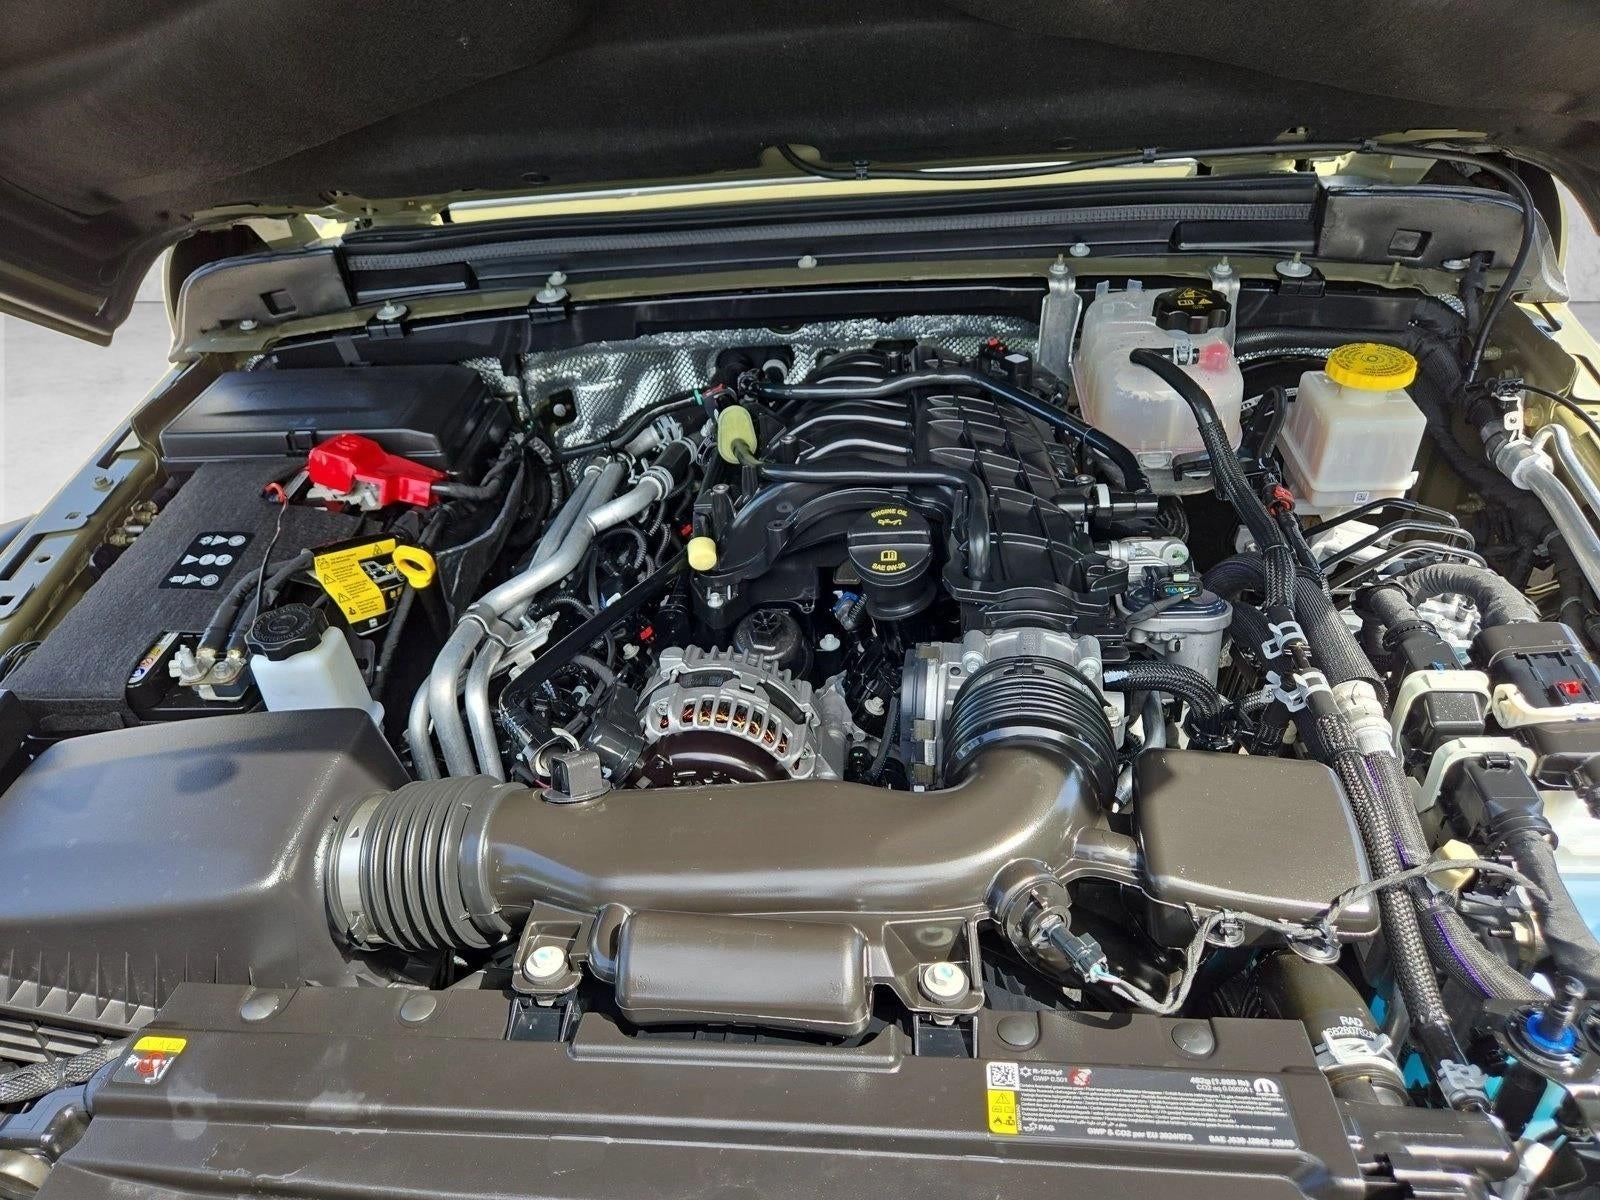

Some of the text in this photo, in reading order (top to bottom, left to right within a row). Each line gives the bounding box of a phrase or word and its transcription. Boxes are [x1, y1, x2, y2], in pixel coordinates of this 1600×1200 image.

[871, 508, 908, 517] ENGINE OIL
[872, 562, 906, 571] SAE 0W-20
[1340, 1016, 1363, 1027] RAD
[1087, 1127, 1107, 1135] GWP
[1114, 1129, 1132, 1137] CO2
